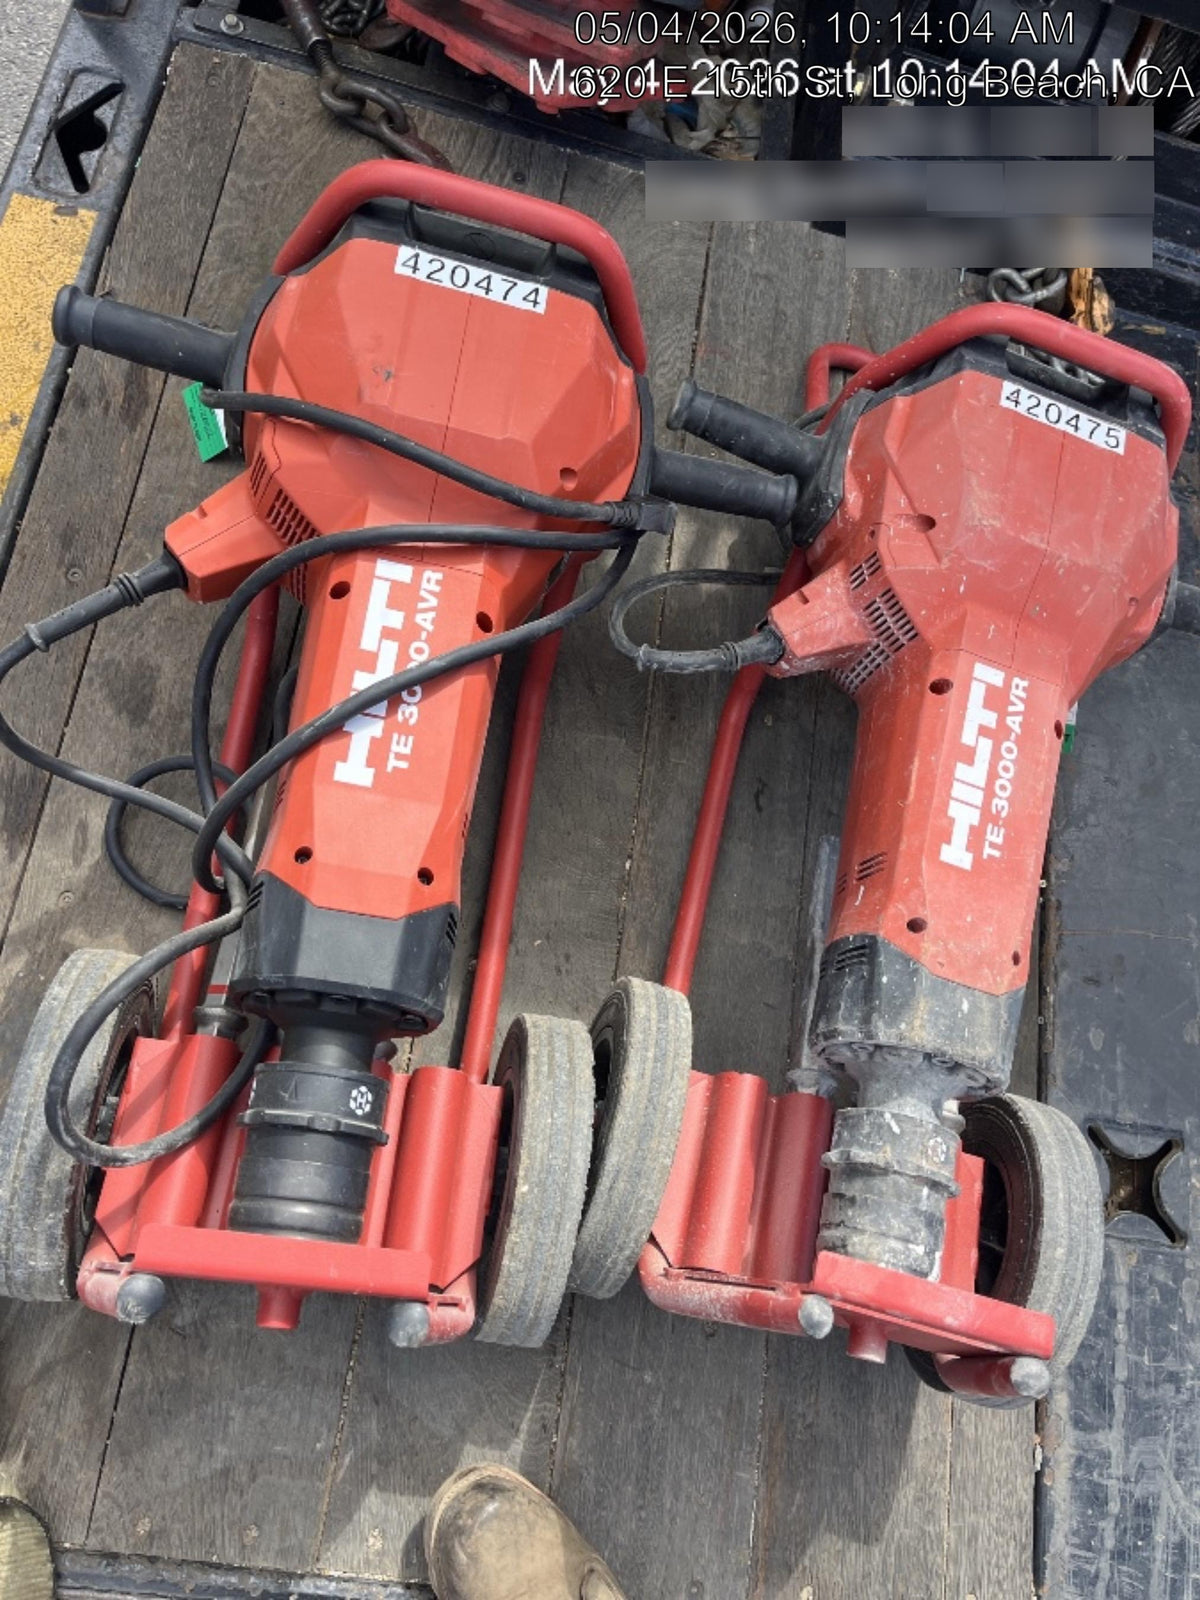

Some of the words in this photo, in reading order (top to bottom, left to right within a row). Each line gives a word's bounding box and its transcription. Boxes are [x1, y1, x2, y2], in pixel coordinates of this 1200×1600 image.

[401, 251, 541, 308] 420474
[1006, 388, 1121, 449] 420475
[333, 558, 414, 788] HLTI
[397, 570, 444, 726] 300-AVR
[387, 732, 414, 773] TE
[939, 662, 1005, 871] HILTI
[991, 677, 1030, 818] 3000-AVR
[983, 822, 1005, 859] TE
